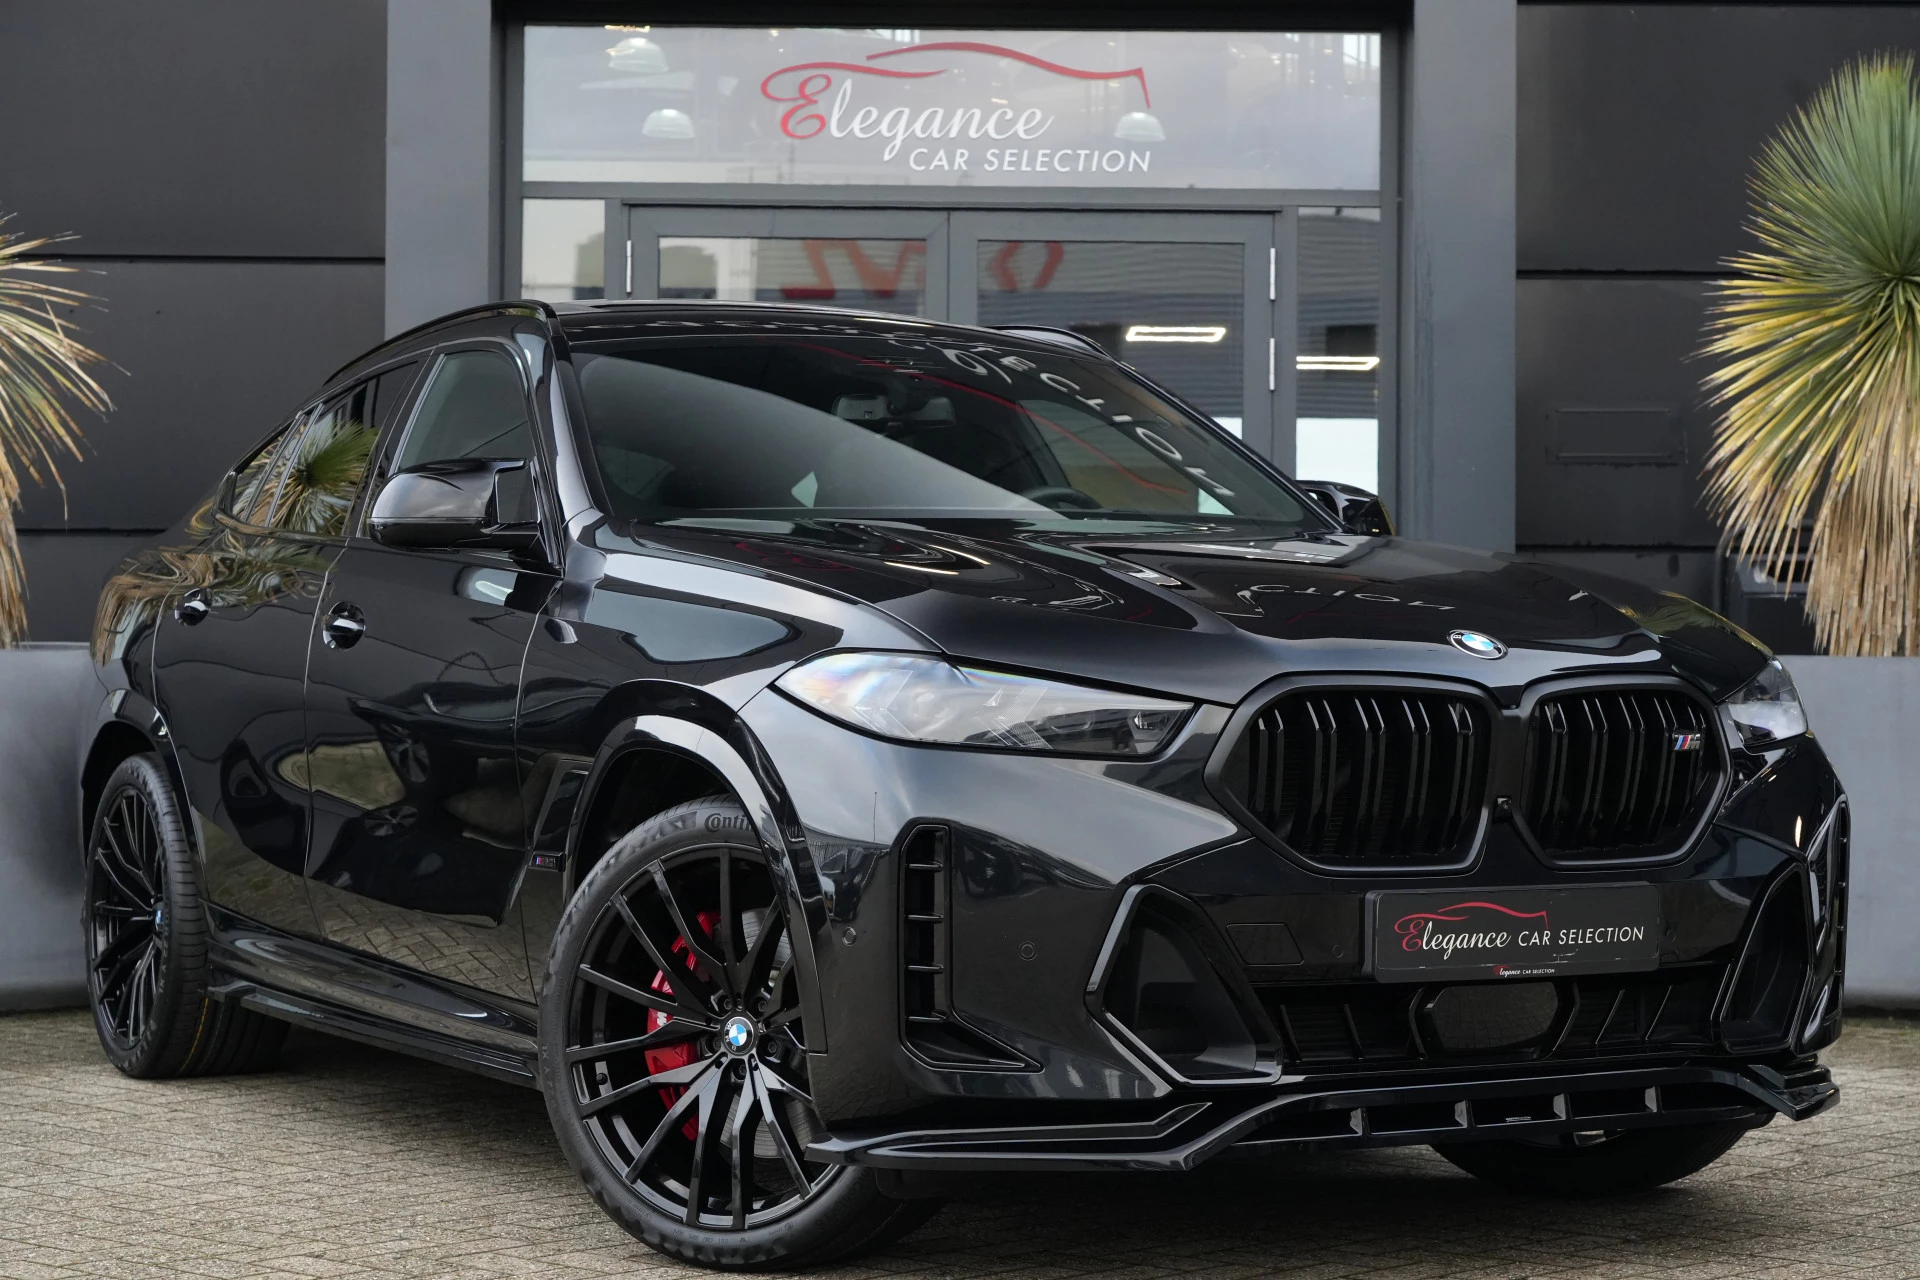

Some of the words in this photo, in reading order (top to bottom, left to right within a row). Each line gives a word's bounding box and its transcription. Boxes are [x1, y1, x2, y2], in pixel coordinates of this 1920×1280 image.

[761, 62, 1054, 162] Elegance
[908, 148, 970, 172] CAR
[983, 148, 1152, 173] SELECTION
[1394, 913, 1512, 960] Elegance
[1518, 929, 1551, 947] CAR
[1558, 926, 1645, 945] SELECTION
